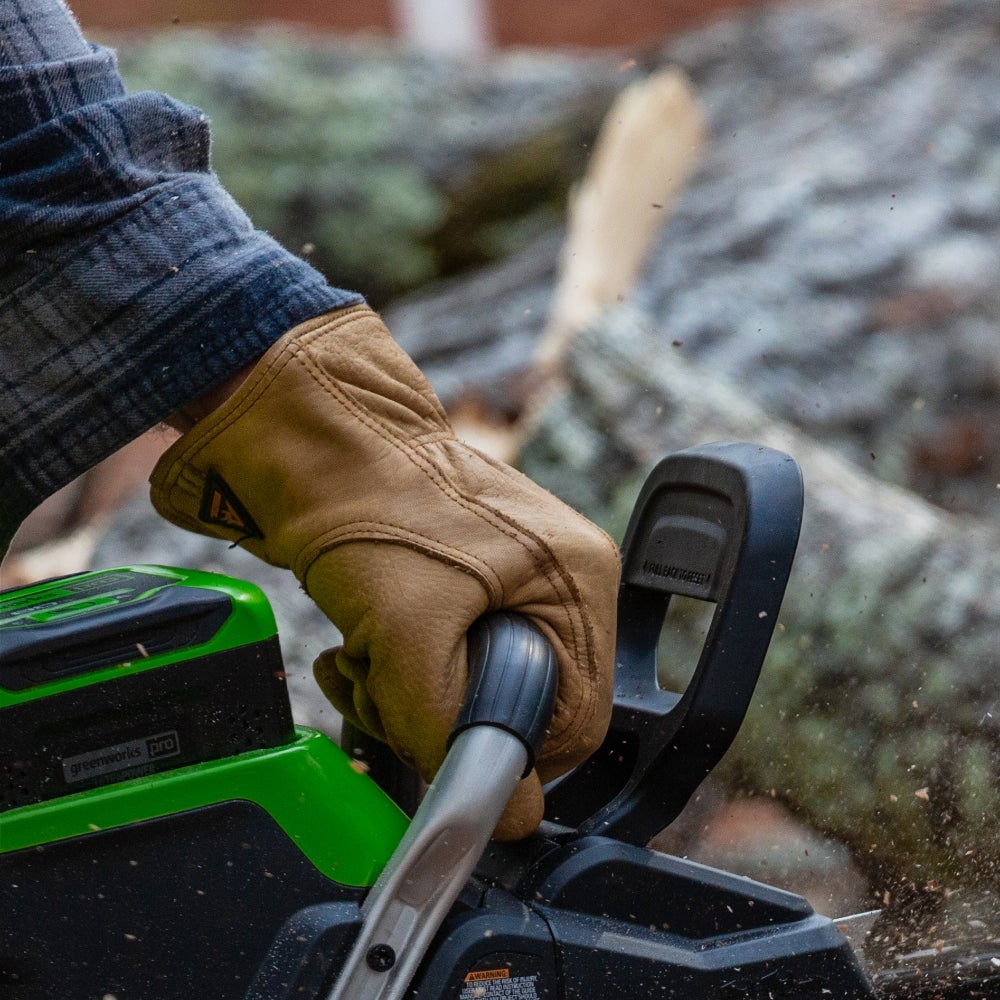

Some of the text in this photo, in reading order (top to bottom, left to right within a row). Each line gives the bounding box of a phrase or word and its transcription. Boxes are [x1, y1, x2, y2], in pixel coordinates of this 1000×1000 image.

[70, 737, 175, 778] greenworks pro
[475, 970, 506, 980] WARNING
